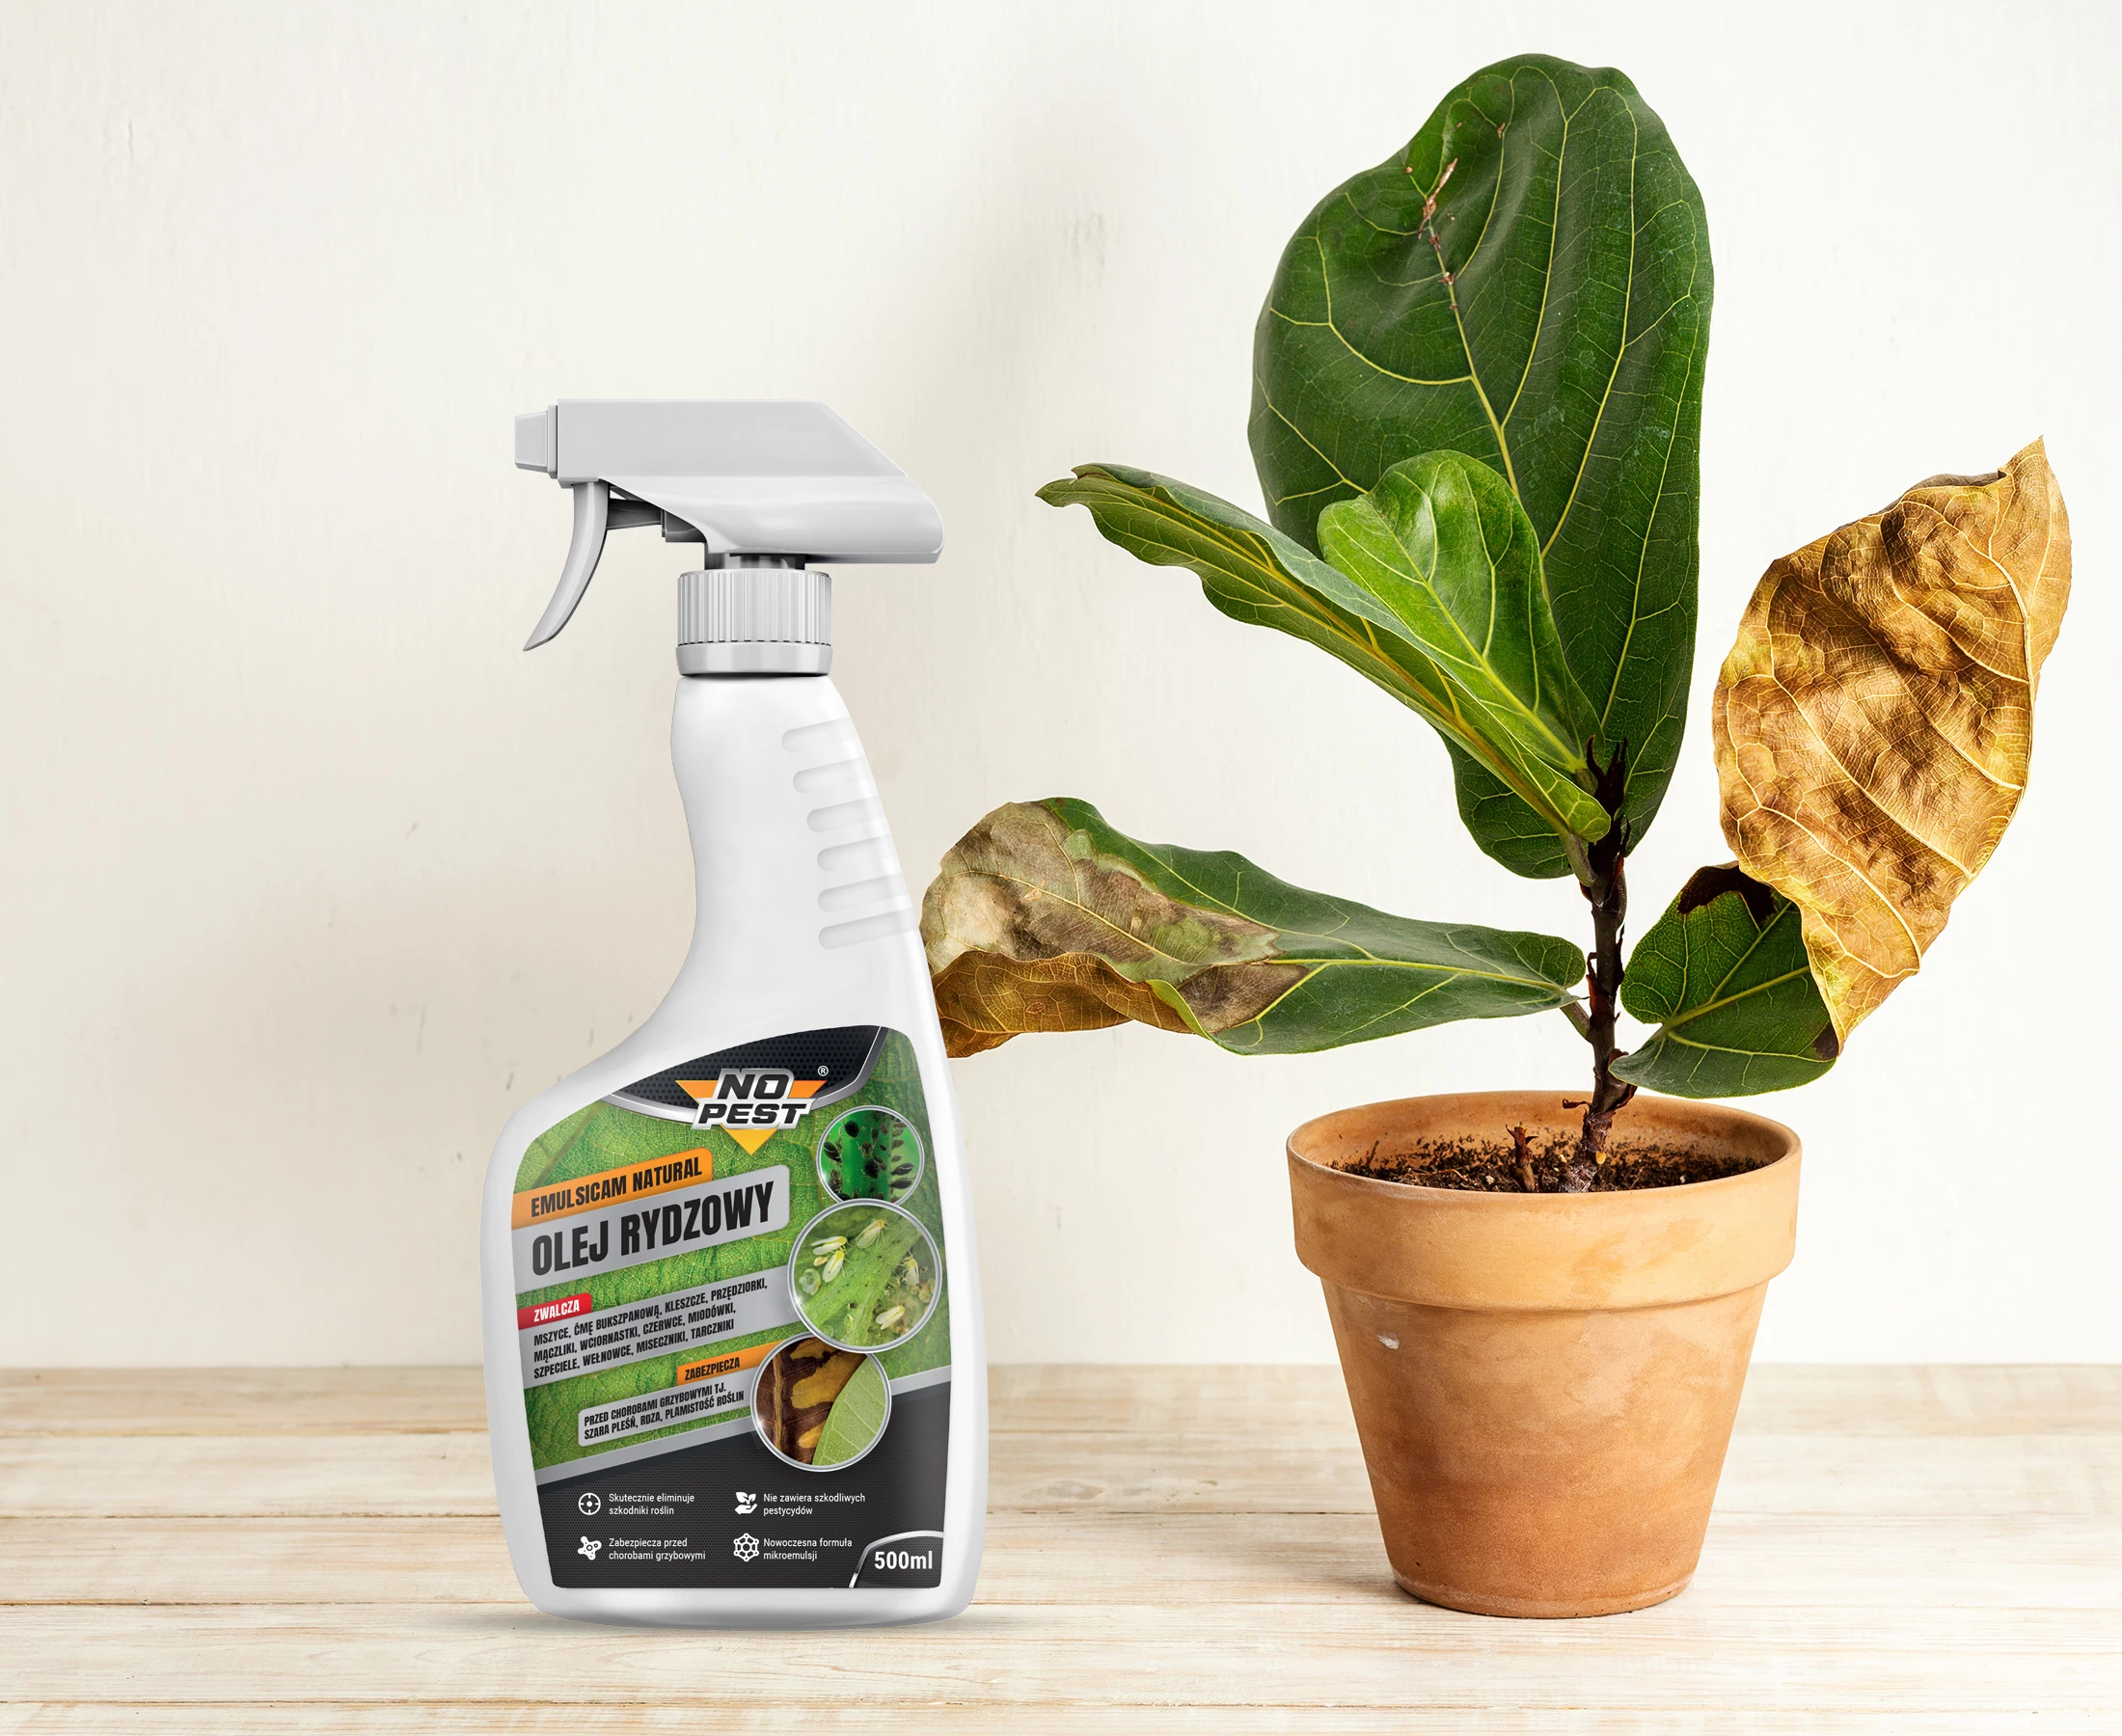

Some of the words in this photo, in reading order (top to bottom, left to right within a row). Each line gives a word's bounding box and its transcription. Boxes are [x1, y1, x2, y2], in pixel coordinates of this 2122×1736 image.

[717, 1073, 790, 1099] NO
[698, 1103, 806, 1125] PEST
[530, 1176, 626, 1217] EMULSICAM
[633, 1156, 702, 1192] NATURAL
[532, 1219, 608, 1277] OLEJ
[620, 1180, 774, 1256] RYDZOWY
[534, 1300, 580, 1321] ZWALCZA
[534, 1329, 571, 1345] MSZYCE,
[574, 1321, 593, 1337] ĆMĘ
[596, 1304, 662, 1330] BUKSZPANOWĄ,
[666, 1293, 708, 1314] KLESZCZE,
[711, 1277, 768, 1302] PRZĘDZIORKI,
[534, 1343, 577, 1364] MĄCZLIKI,
[580, 1327, 640, 1350] WCIORNASTKI,
[643, 1317, 685, 1335] CZERWCE,
[688, 1302, 736, 1323] MIODÓWKI,
[534, 1360, 580, 1379] SZPECIELE,
[583, 1346, 634, 1367] WEŁNOWCE,
[637, 1333, 688, 1353] MISECZNIKI,
[691, 1319, 734, 1339] TARCZNIKI
[685, 1358, 740, 1380] ZABEZPIECZA
[585, 1412, 608, 1426] PRZED
[612, 1400, 658, 1420] CHOROBAMI
[660, 1385, 712, 1408] GRZYBOWYMI
[585, 1424, 610, 1440] SZARA
[640, 1414, 663, 1425] RDZA,
[666, 1397, 715, 1420] PLAMISTOŚĆ
[717, 1391, 744, 1406] ROŚLIN
[609, 1493, 654, 1503] Skutecznie
[657, 1493, 694, 1505] eliminuje
[763, 1493, 776, 1503] Nie
[779, 1493, 811, 1503] zawiera
[814, 1493, 865, 1505] szkodliwych
[609, 1505, 647, 1515] szkodniki
[649, 1505, 674, 1515] roślin
[763, 1505, 813, 1518] pestycydów
[609, 1538, 661, 1550] Zabezpiecza
[664, 1537, 687, 1550] przed
[763, 1538, 816, 1547] Nowoczesna
[819, 1537, 853, 1547] formuła
[609, 1551, 653, 1560] chorobami
[656, 1551, 706, 1562] grzybowymi
[763, 1551, 817, 1562] mikroemulsji
[874, 1551, 933, 1570] 500ml
